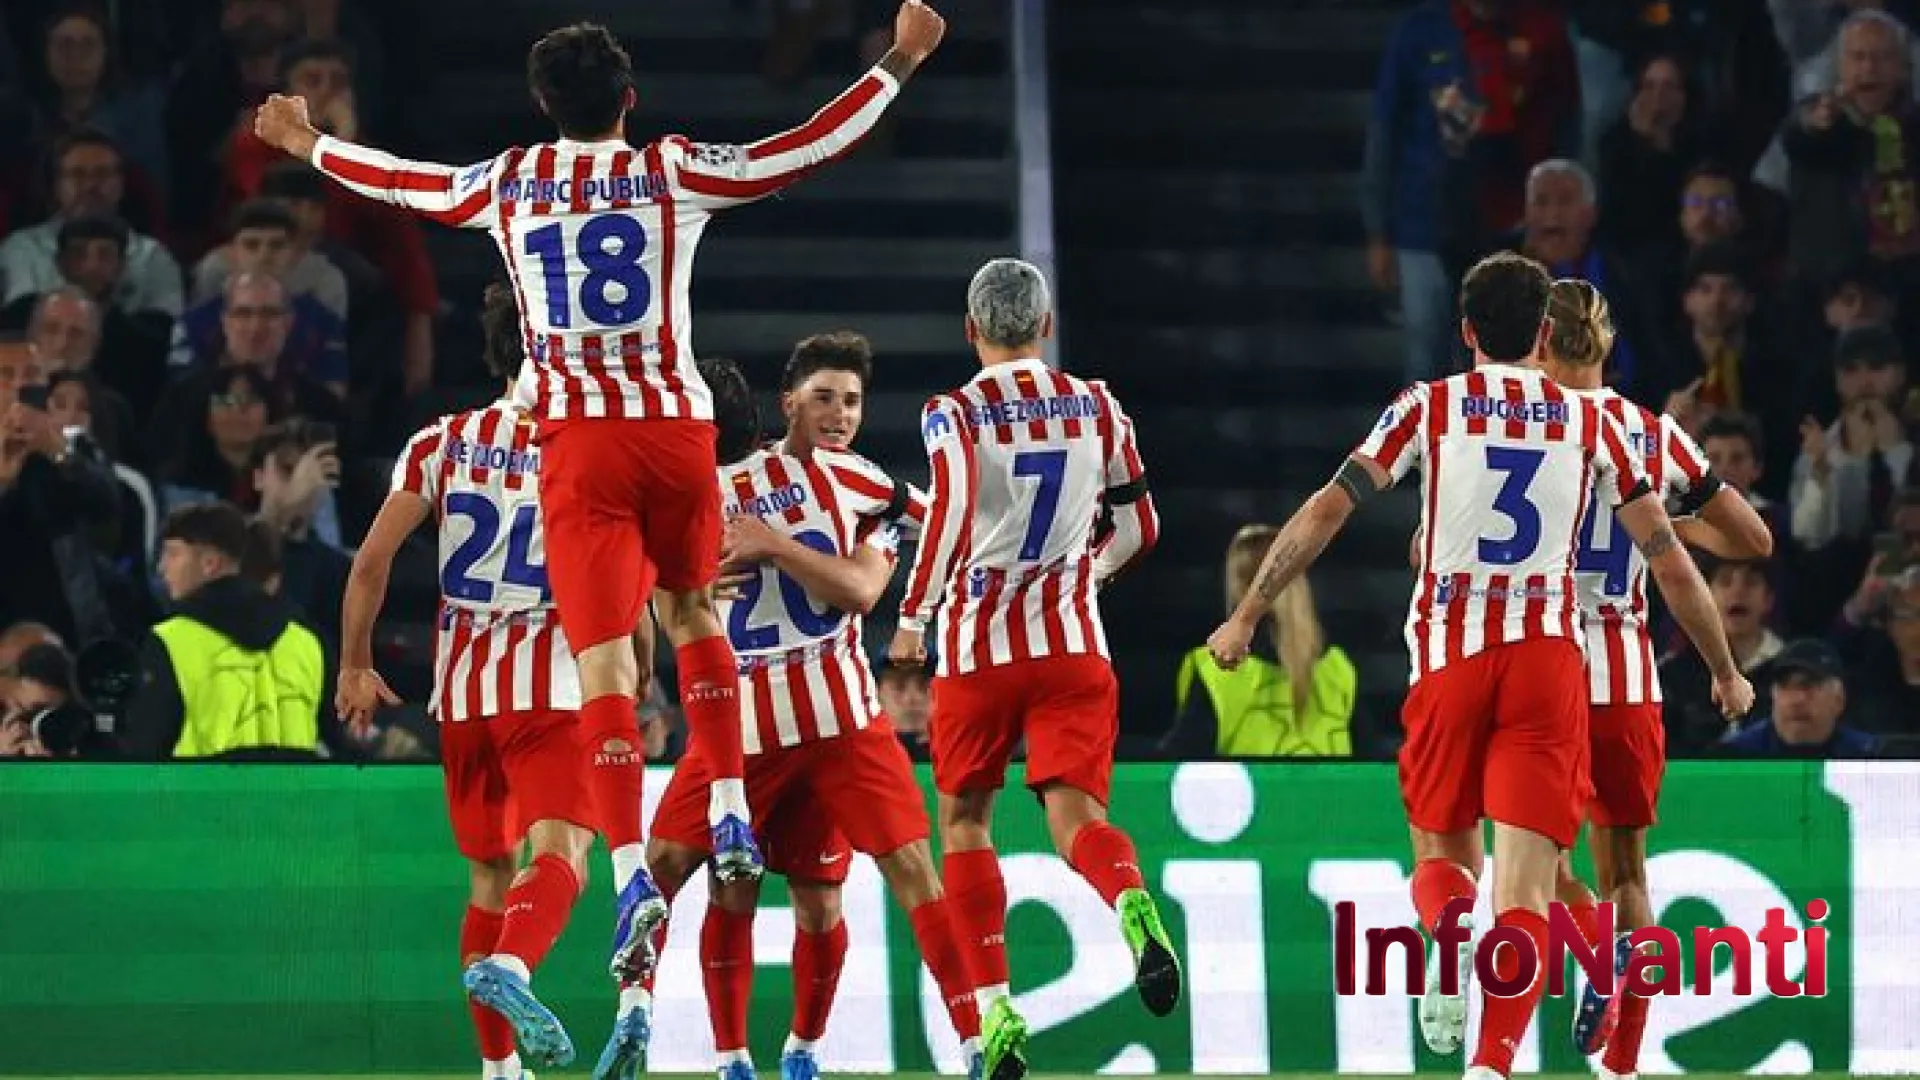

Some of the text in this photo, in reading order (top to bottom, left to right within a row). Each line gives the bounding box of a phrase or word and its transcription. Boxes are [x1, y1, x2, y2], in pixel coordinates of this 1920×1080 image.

[500, 178, 571, 203] MARC
[524, 213, 652, 328] 18
[472, 446, 539, 473] NORM
[1461, 396, 1569, 422] RUGGERI
[443, 492, 553, 602] 24
[1012, 450, 1068, 561] 7
[1477, 446, 1548, 565] 3
[728, 529, 846, 651] 20
